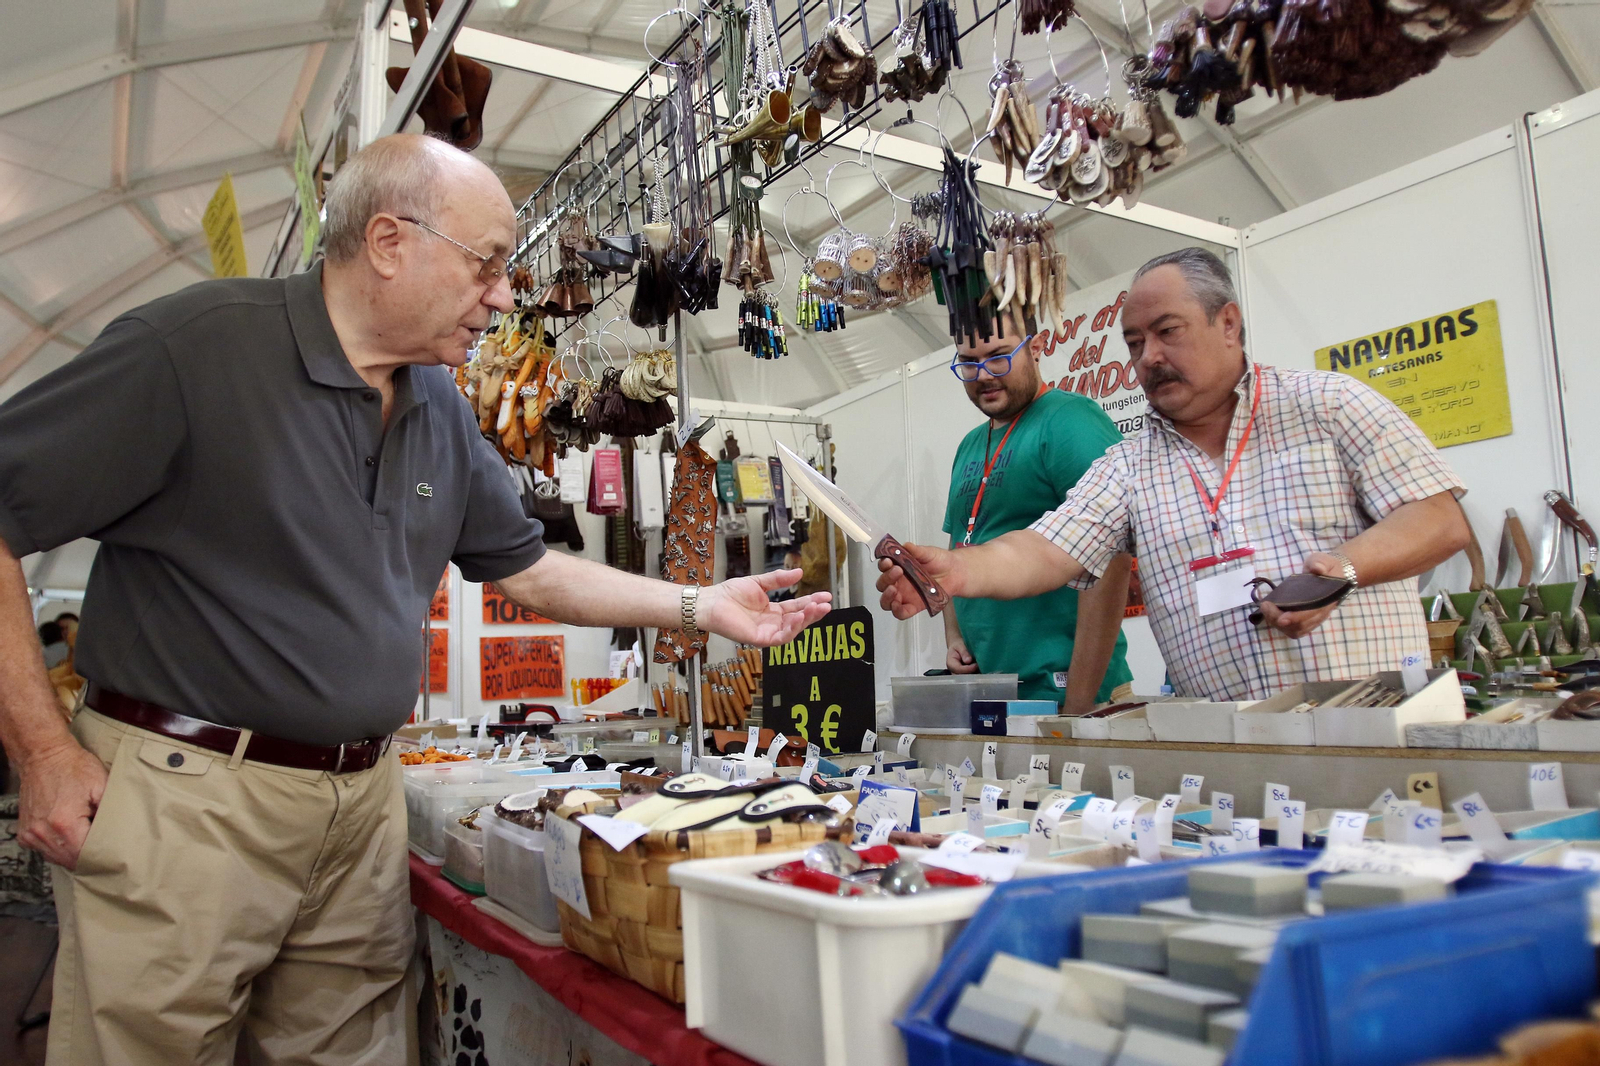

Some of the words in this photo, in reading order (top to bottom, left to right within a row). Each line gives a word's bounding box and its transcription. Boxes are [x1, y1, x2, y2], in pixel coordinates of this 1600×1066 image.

[1329, 308, 1479, 372] NAVAJAS
[1069, 335, 1107, 372] del
[1368, 351, 1443, 378] ARTESANAS
[1102, 394, 1147, 411] tungsten
[769, 621, 866, 667] NAVAJAS
[484, 641, 516, 672] SUPER
[518, 639, 560, 666] OFERTAS
[485, 673, 503, 698] POR
[809, 676, 821, 701] A
[791, 704, 809, 744] 3
[820, 704, 842, 754] €
[1033, 758, 1049, 771] 10€
[1117, 770, 1131, 780] 6€
[1530, 766, 1557, 781] 10€
[1181, 777, 1201, 788] 15€
[1218, 798, 1234, 810] 5€
[1272, 788, 1288, 801] 8€
[1283, 806, 1302, 818] 9€
[1034, 818, 1052, 840] 5€
[1231, 821, 1260, 842] 5€
